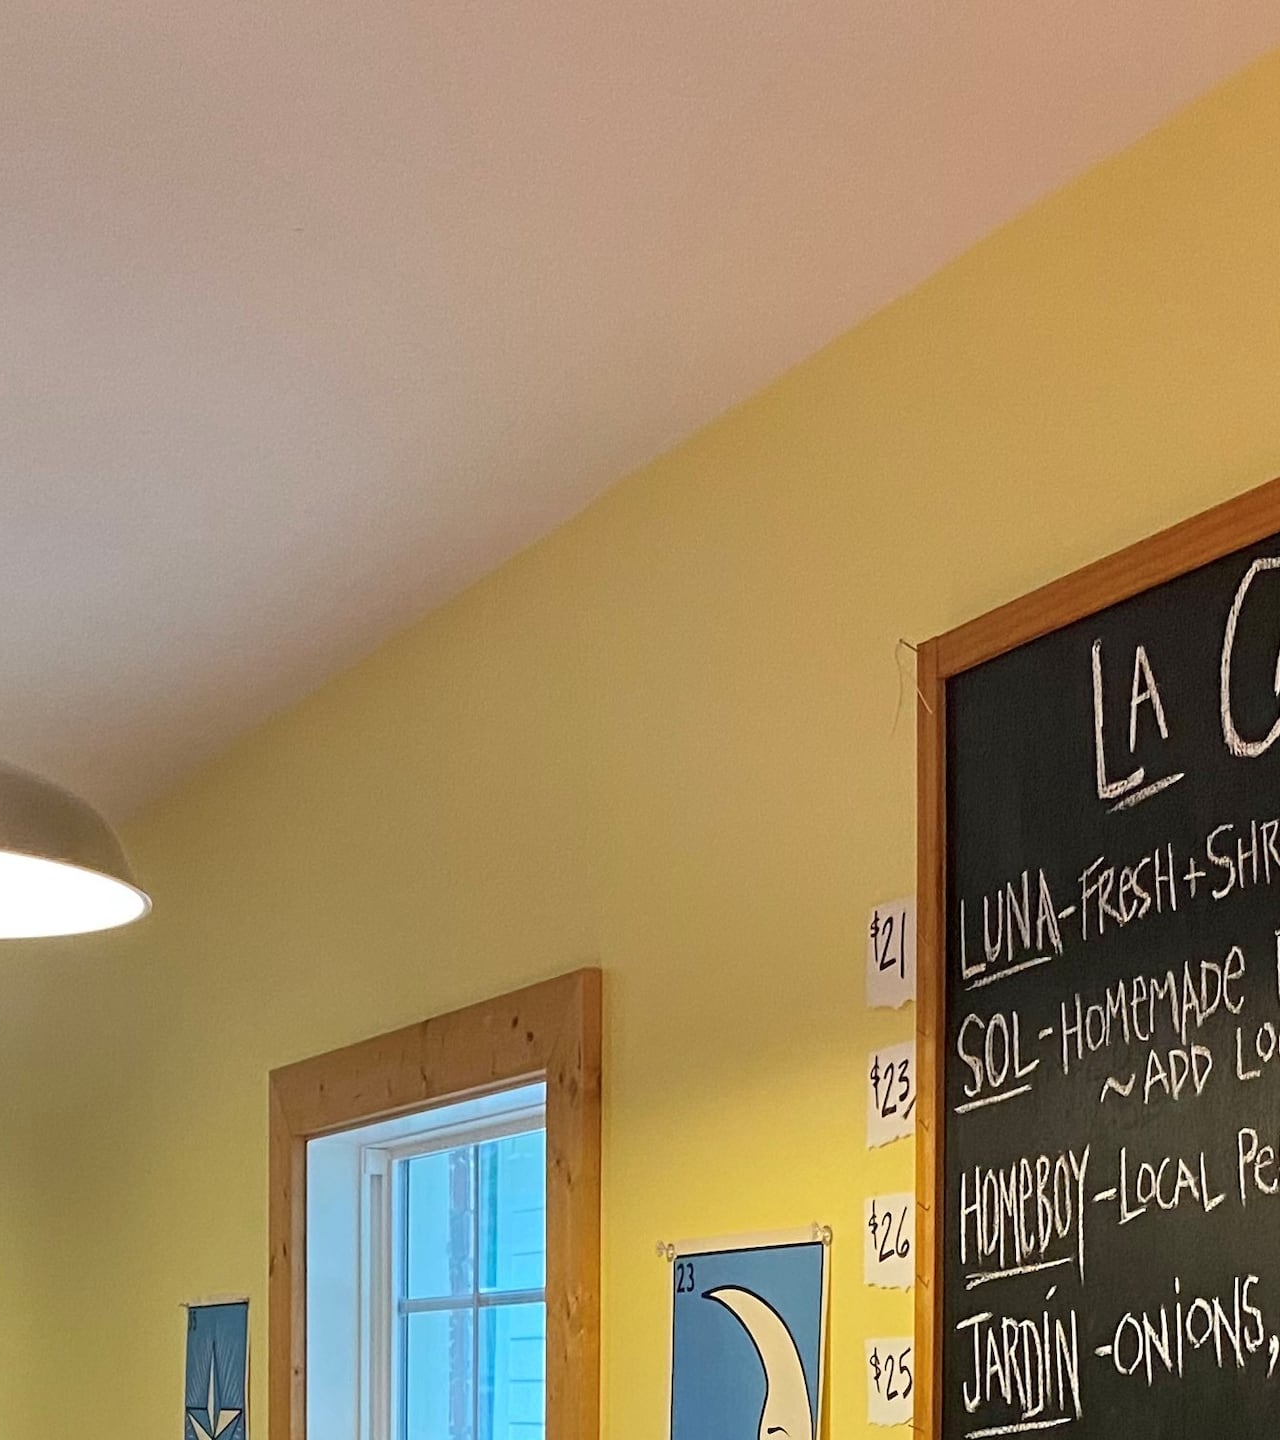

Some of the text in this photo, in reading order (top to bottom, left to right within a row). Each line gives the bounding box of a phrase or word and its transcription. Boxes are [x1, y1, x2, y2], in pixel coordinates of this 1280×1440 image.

[1092, 637, 1169, 800] LA
[871, 910, 906, 979] $21
[869, 1200, 910, 1263] $26
[676, 1262, 695, 1293] 23
[870, 1347, 913, 1401] $25
